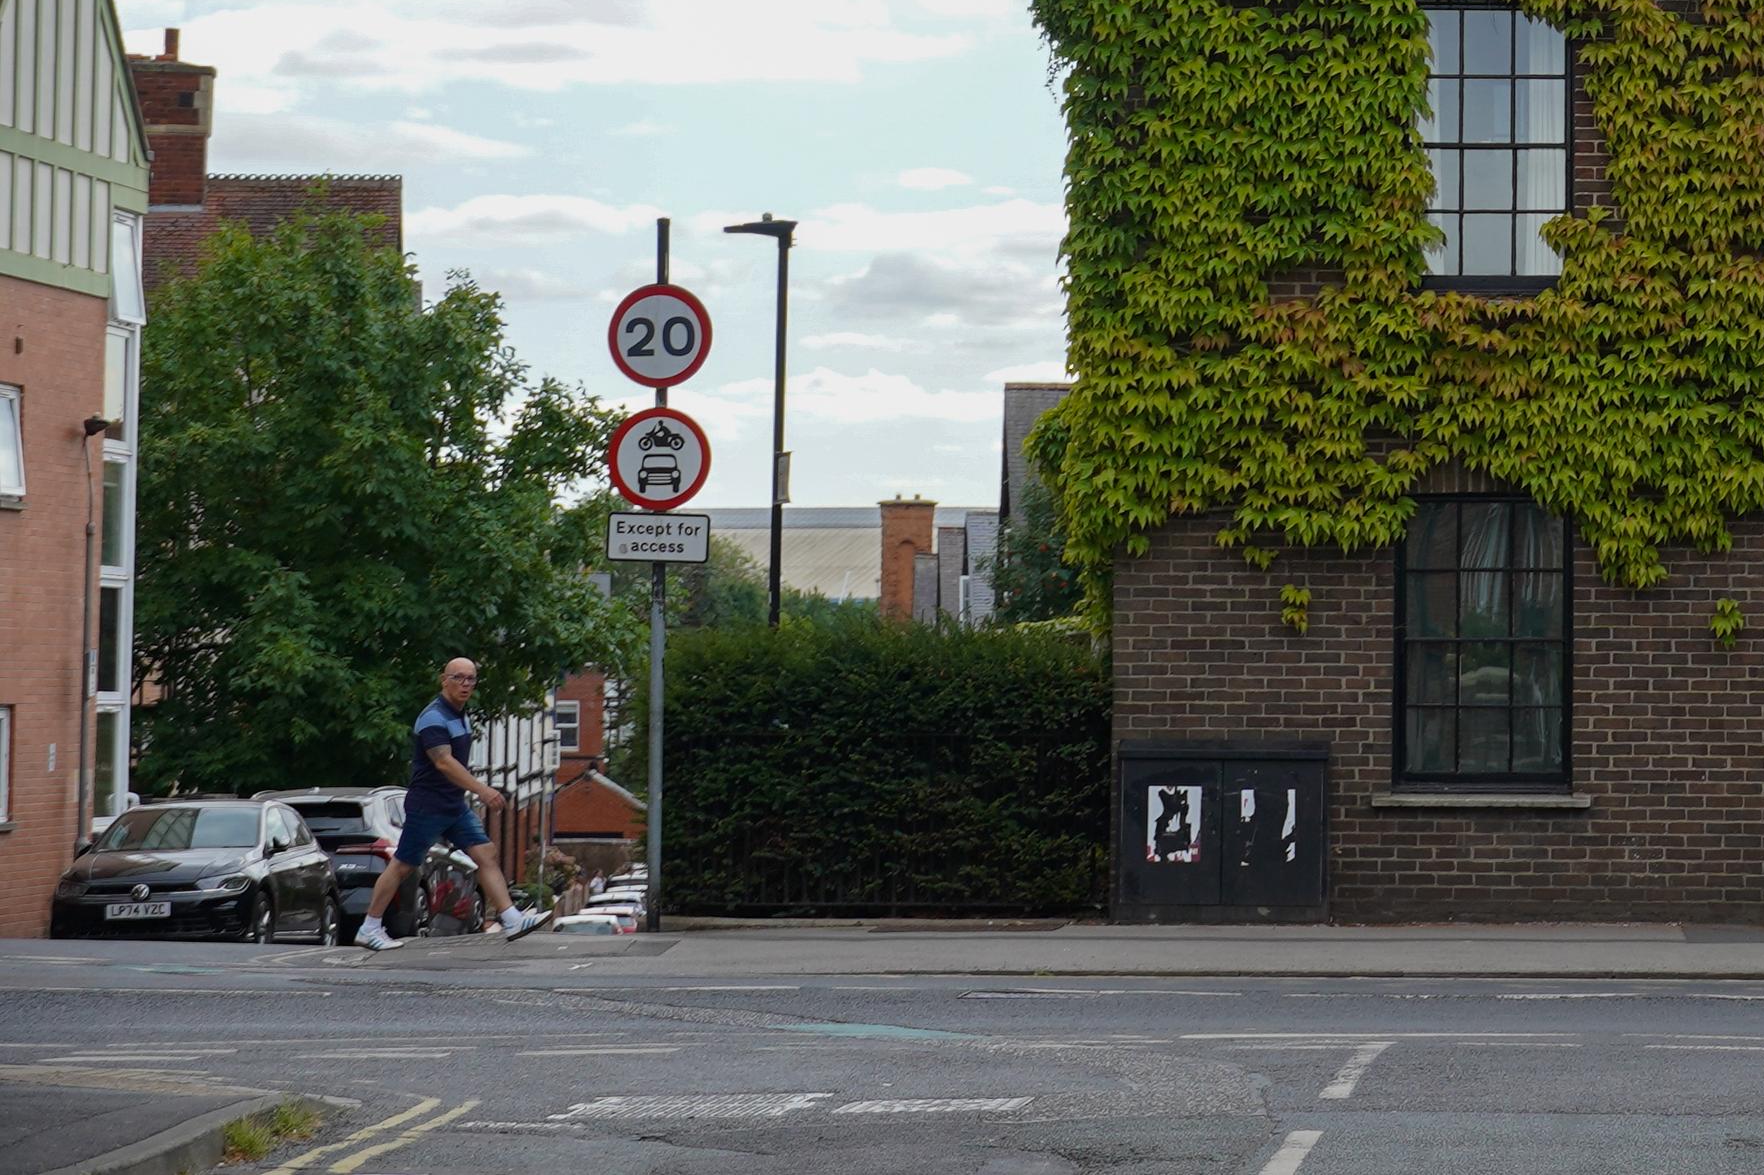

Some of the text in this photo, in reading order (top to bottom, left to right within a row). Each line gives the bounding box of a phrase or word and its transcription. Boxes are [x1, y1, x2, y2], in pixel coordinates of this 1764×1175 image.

[625, 316, 696, 358] 20
[616, 520, 702, 537] Except for
[630, 541, 685, 554] access
[111, 905, 140, 917] LP74
